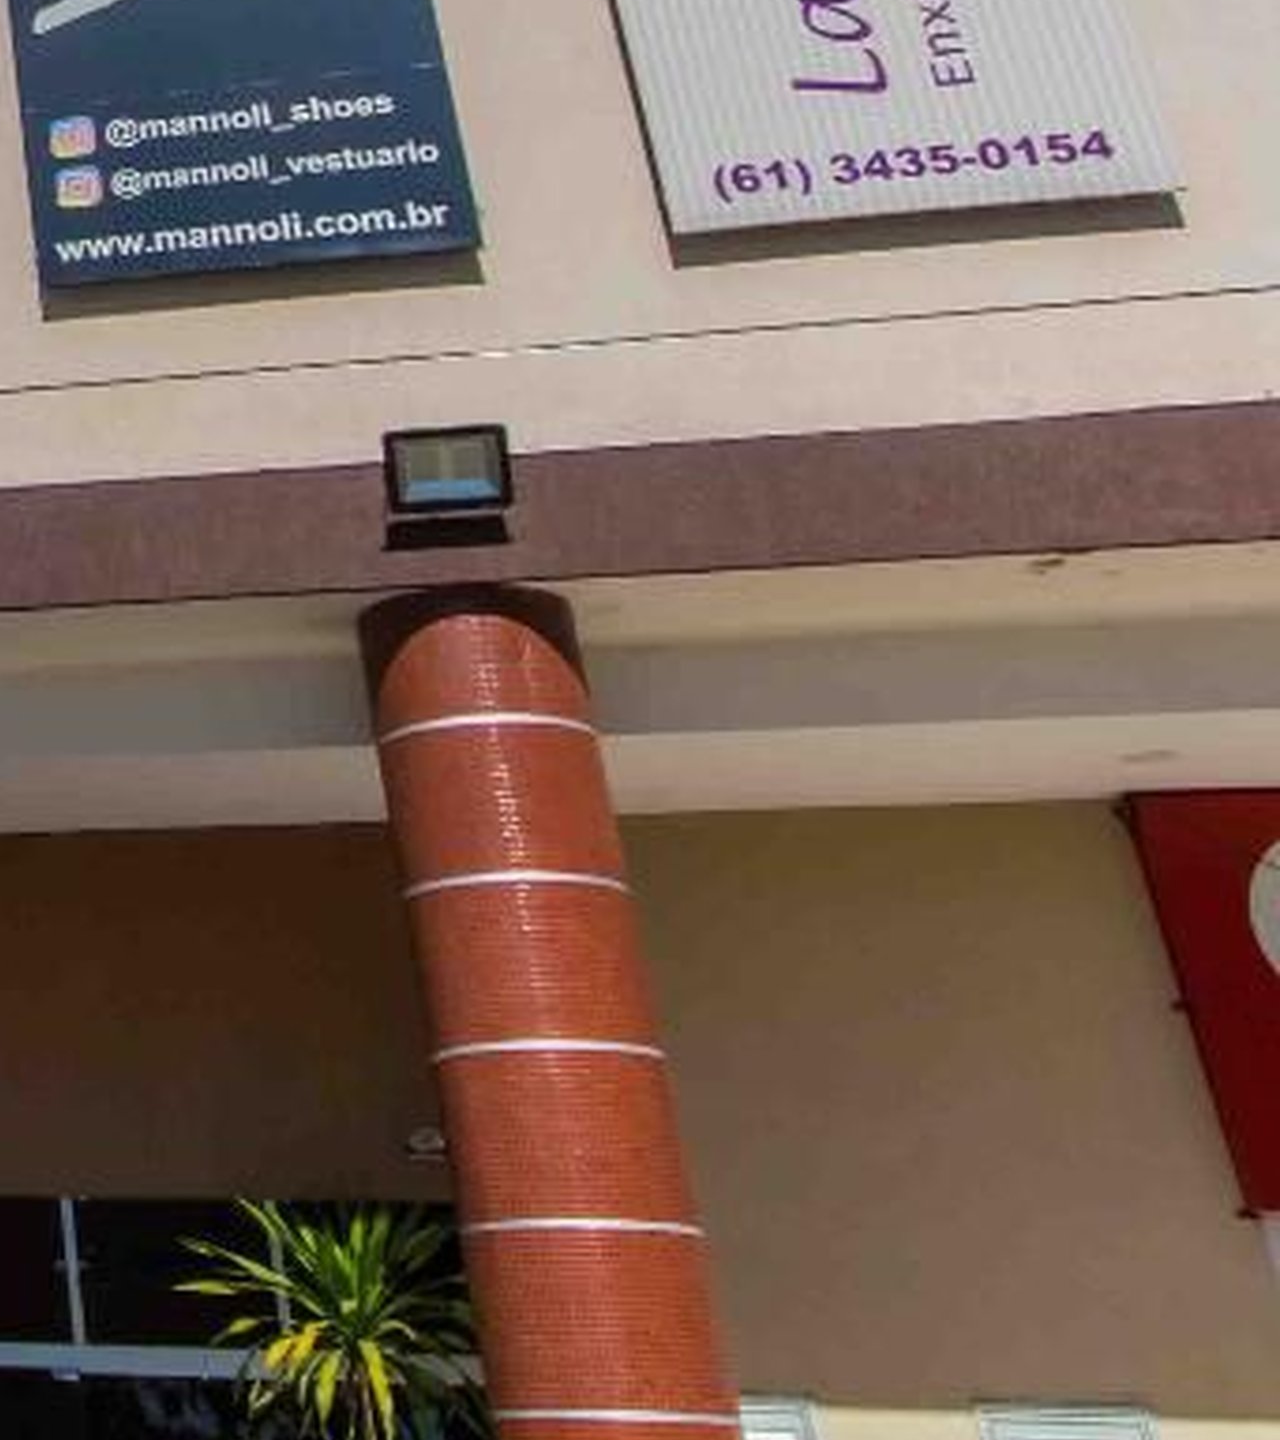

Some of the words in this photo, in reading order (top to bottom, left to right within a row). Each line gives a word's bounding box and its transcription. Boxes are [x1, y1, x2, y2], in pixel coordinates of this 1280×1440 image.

[106, 90, 396, 148] @mannoli_shoes
[712, 156, 813, 202] (61)
[830, 128, 1115, 187] 3435-0154
[54, 200, 450, 263] www.mannoli.com.br
